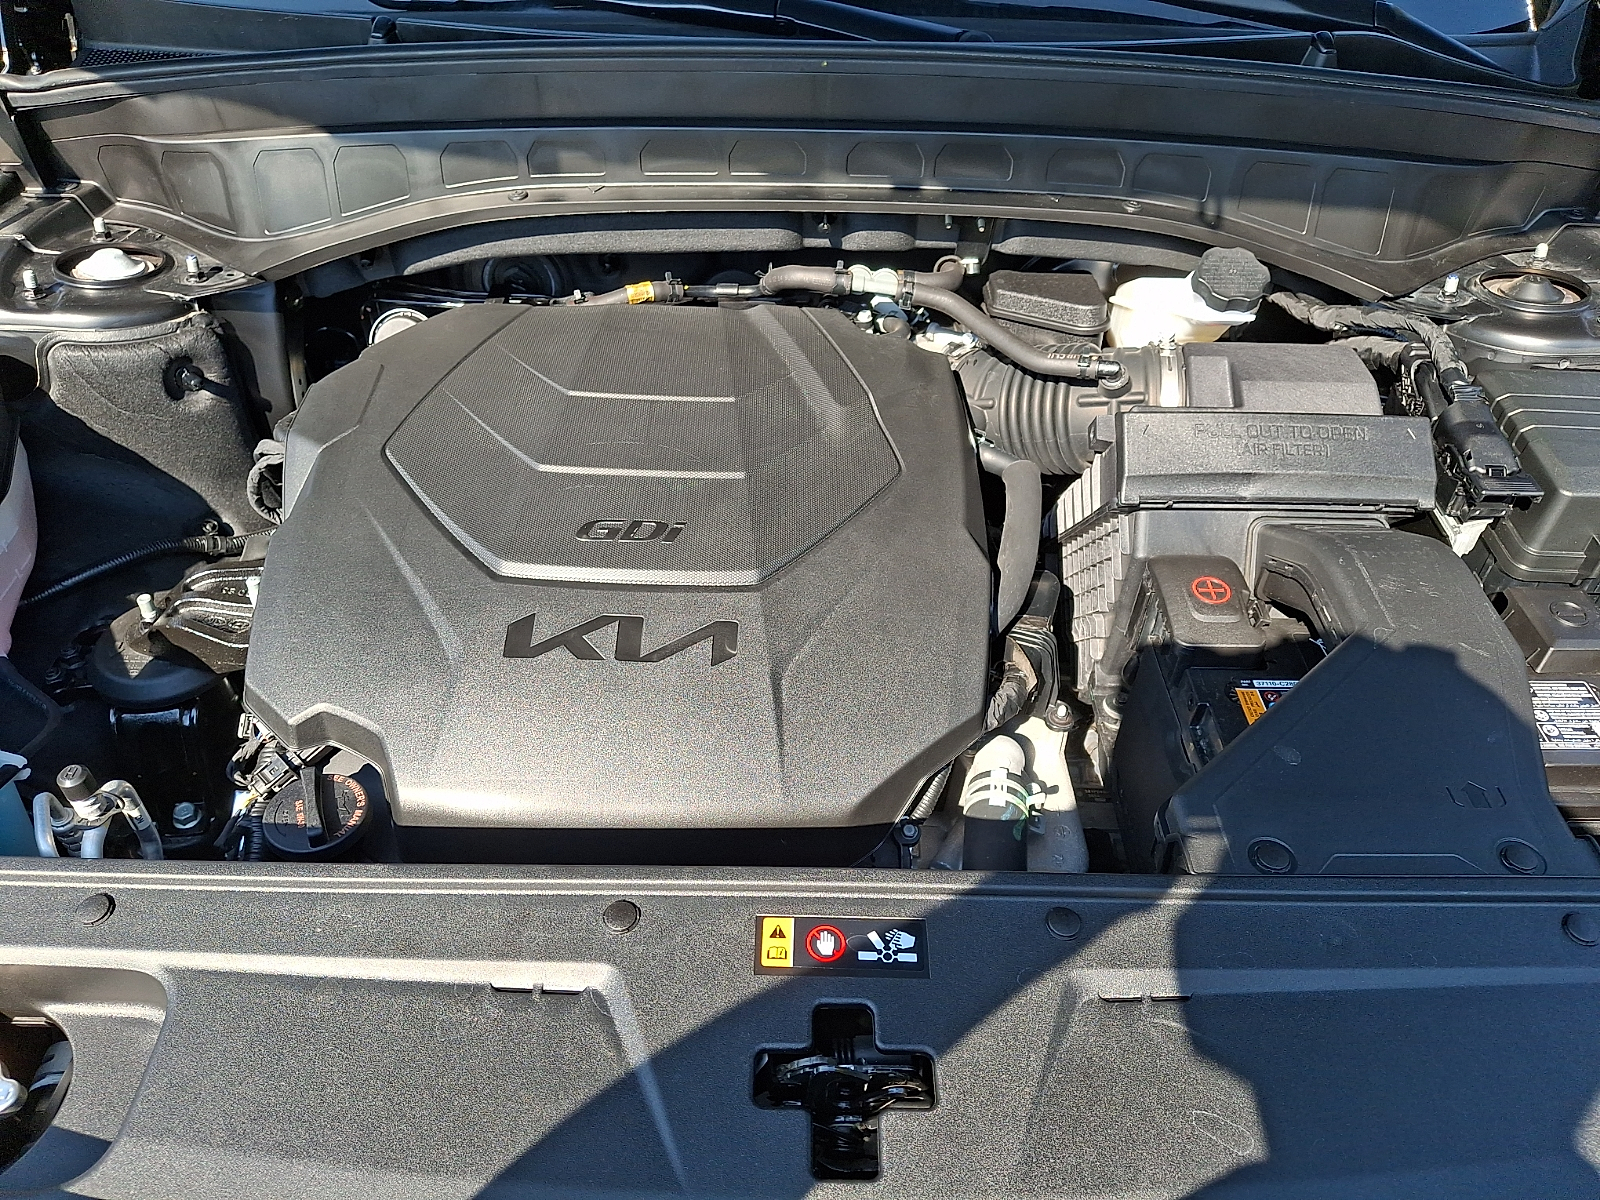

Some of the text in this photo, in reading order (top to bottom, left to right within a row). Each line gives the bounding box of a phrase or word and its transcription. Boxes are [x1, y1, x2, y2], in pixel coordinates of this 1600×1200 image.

[1194, 423, 1369, 441] PULL OUT TO OPEN
[1272, 442, 1331, 458] FILTER)
[575, 519, 688, 544] GDi
[503, 612, 740, 667] KIA
[327, 774, 346, 783] SEE
[333, 809, 364, 838] MANUAL
